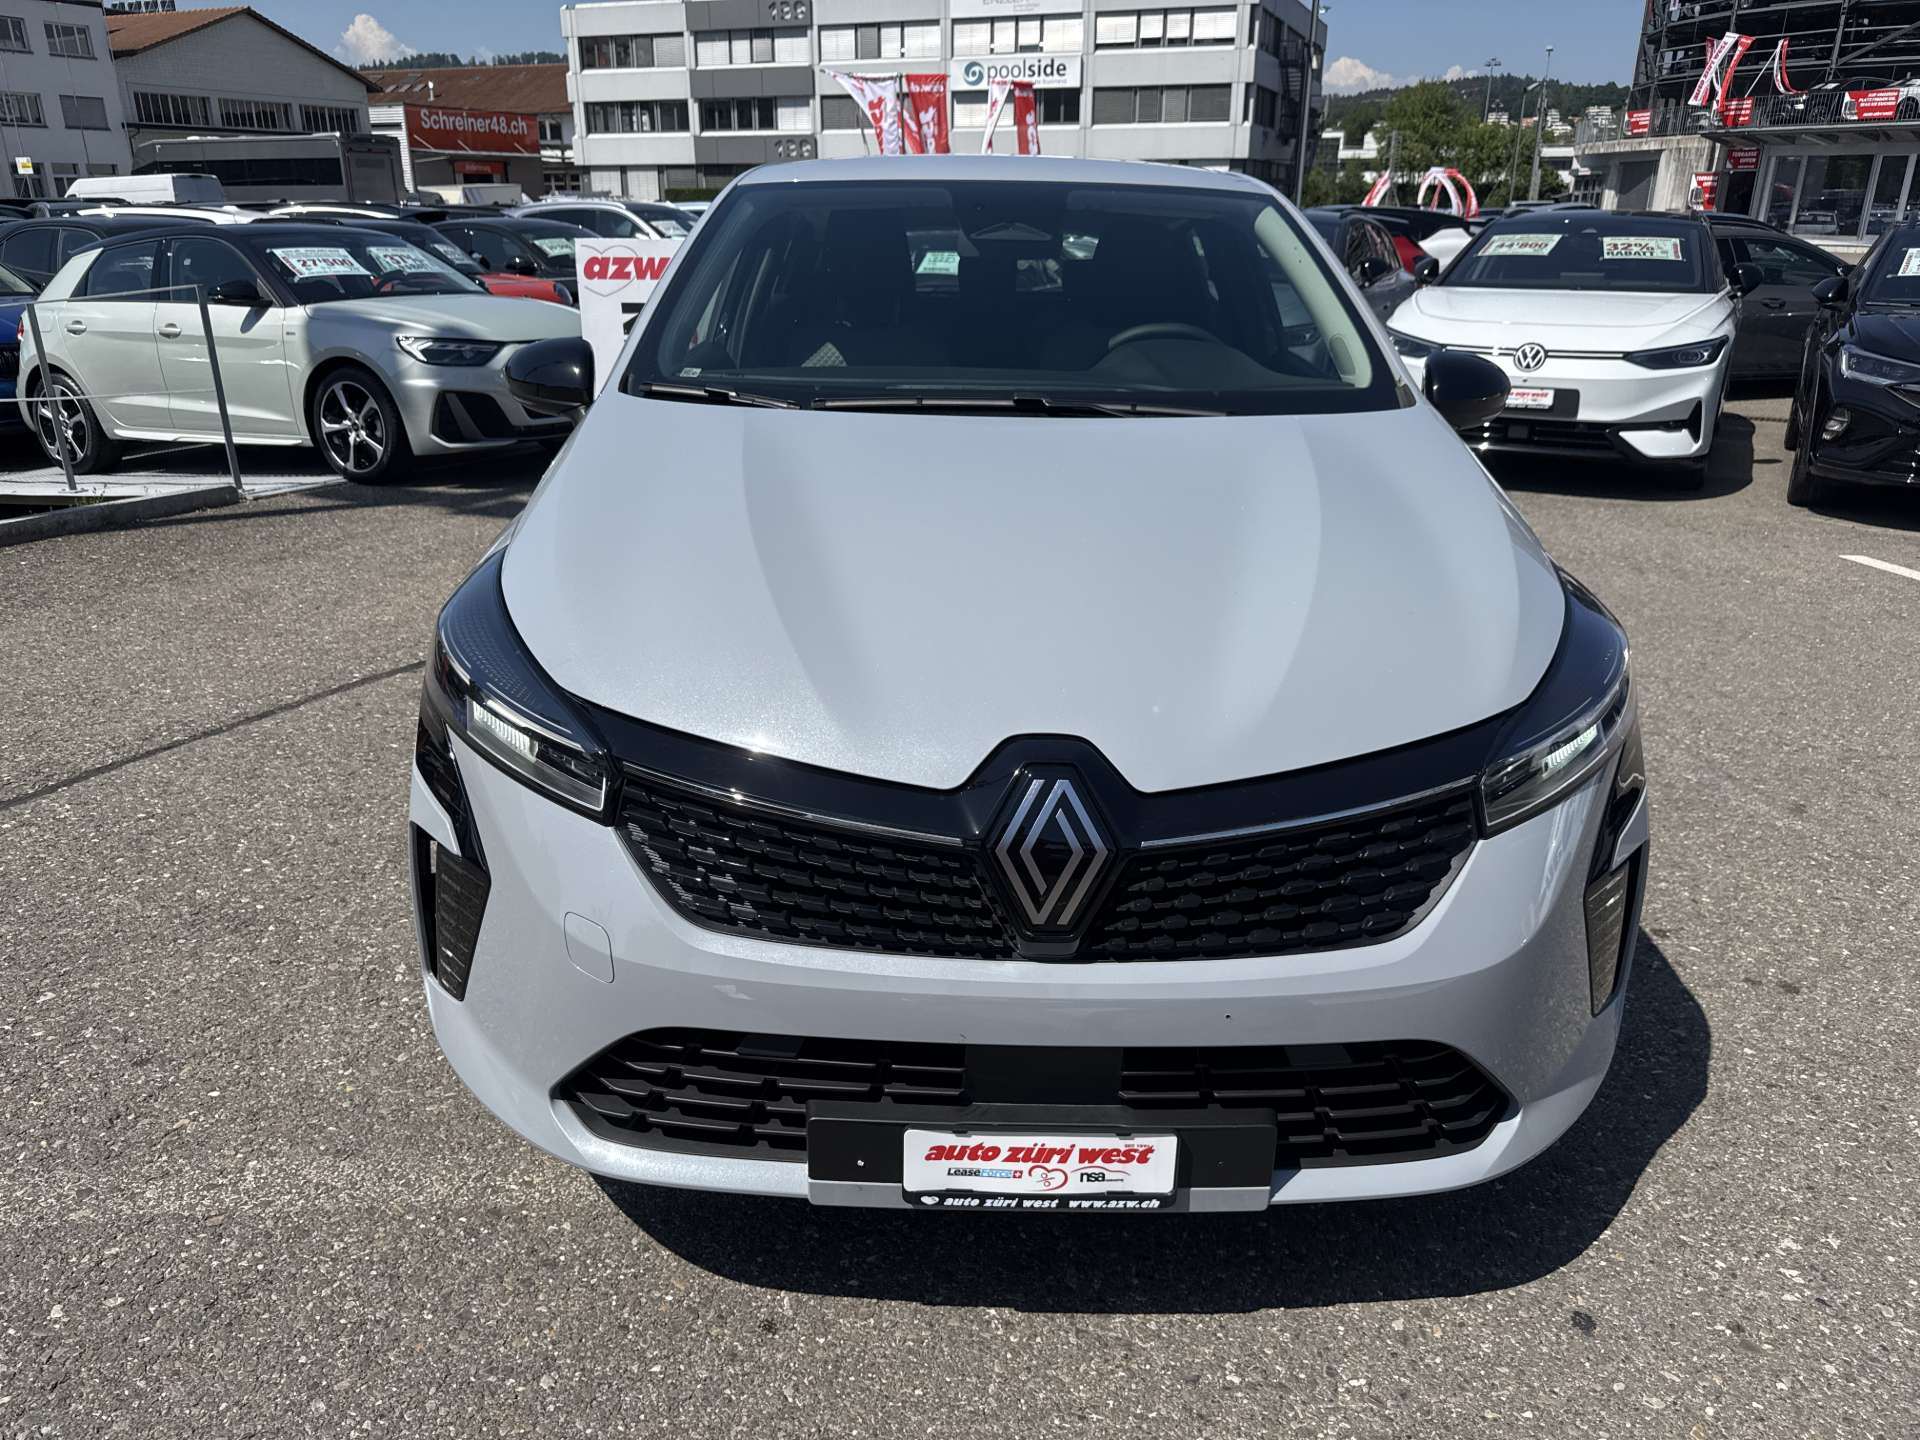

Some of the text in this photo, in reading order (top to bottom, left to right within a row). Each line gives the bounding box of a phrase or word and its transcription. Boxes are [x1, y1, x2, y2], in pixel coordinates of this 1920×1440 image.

[987, 58, 1067, 86] poolside
[420, 108, 528, 135] Schreiner48.ch
[1606, 242, 1655, 251] 32%
[583, 256, 671, 281] azw
[924, 1142, 1156, 1165] auto züri west
[1080, 1169, 1105, 1182] nsa
[943, 1196, 1161, 1209] auto züri west www.azw.ch
